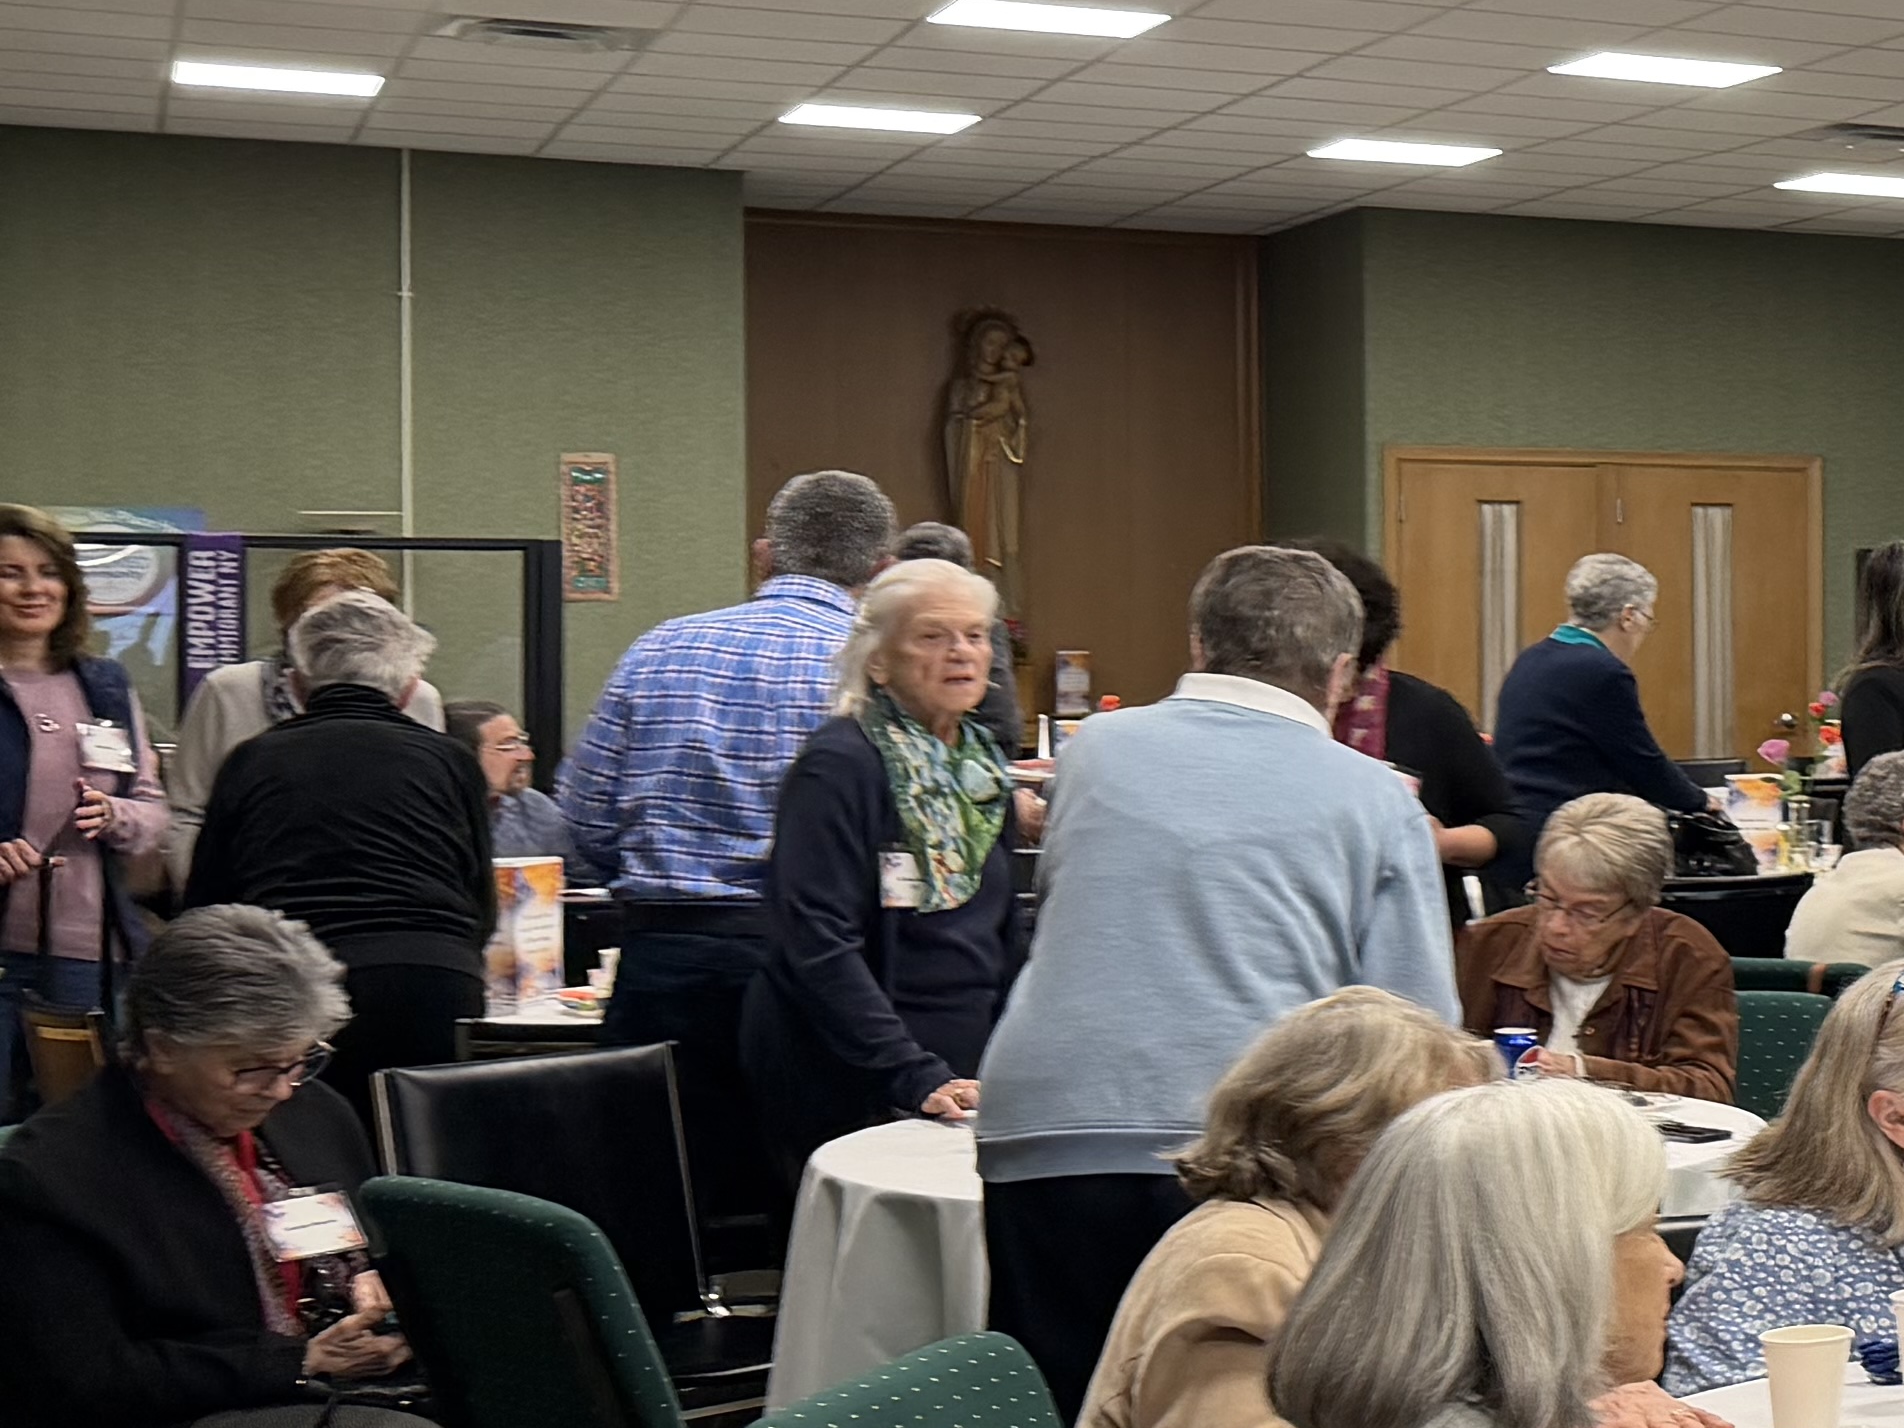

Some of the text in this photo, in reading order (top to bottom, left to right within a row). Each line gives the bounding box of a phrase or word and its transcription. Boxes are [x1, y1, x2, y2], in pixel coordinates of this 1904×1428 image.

[186, 550, 217, 669] EMPOWER
[216, 549, 240, 663] MMIGRANT NY
